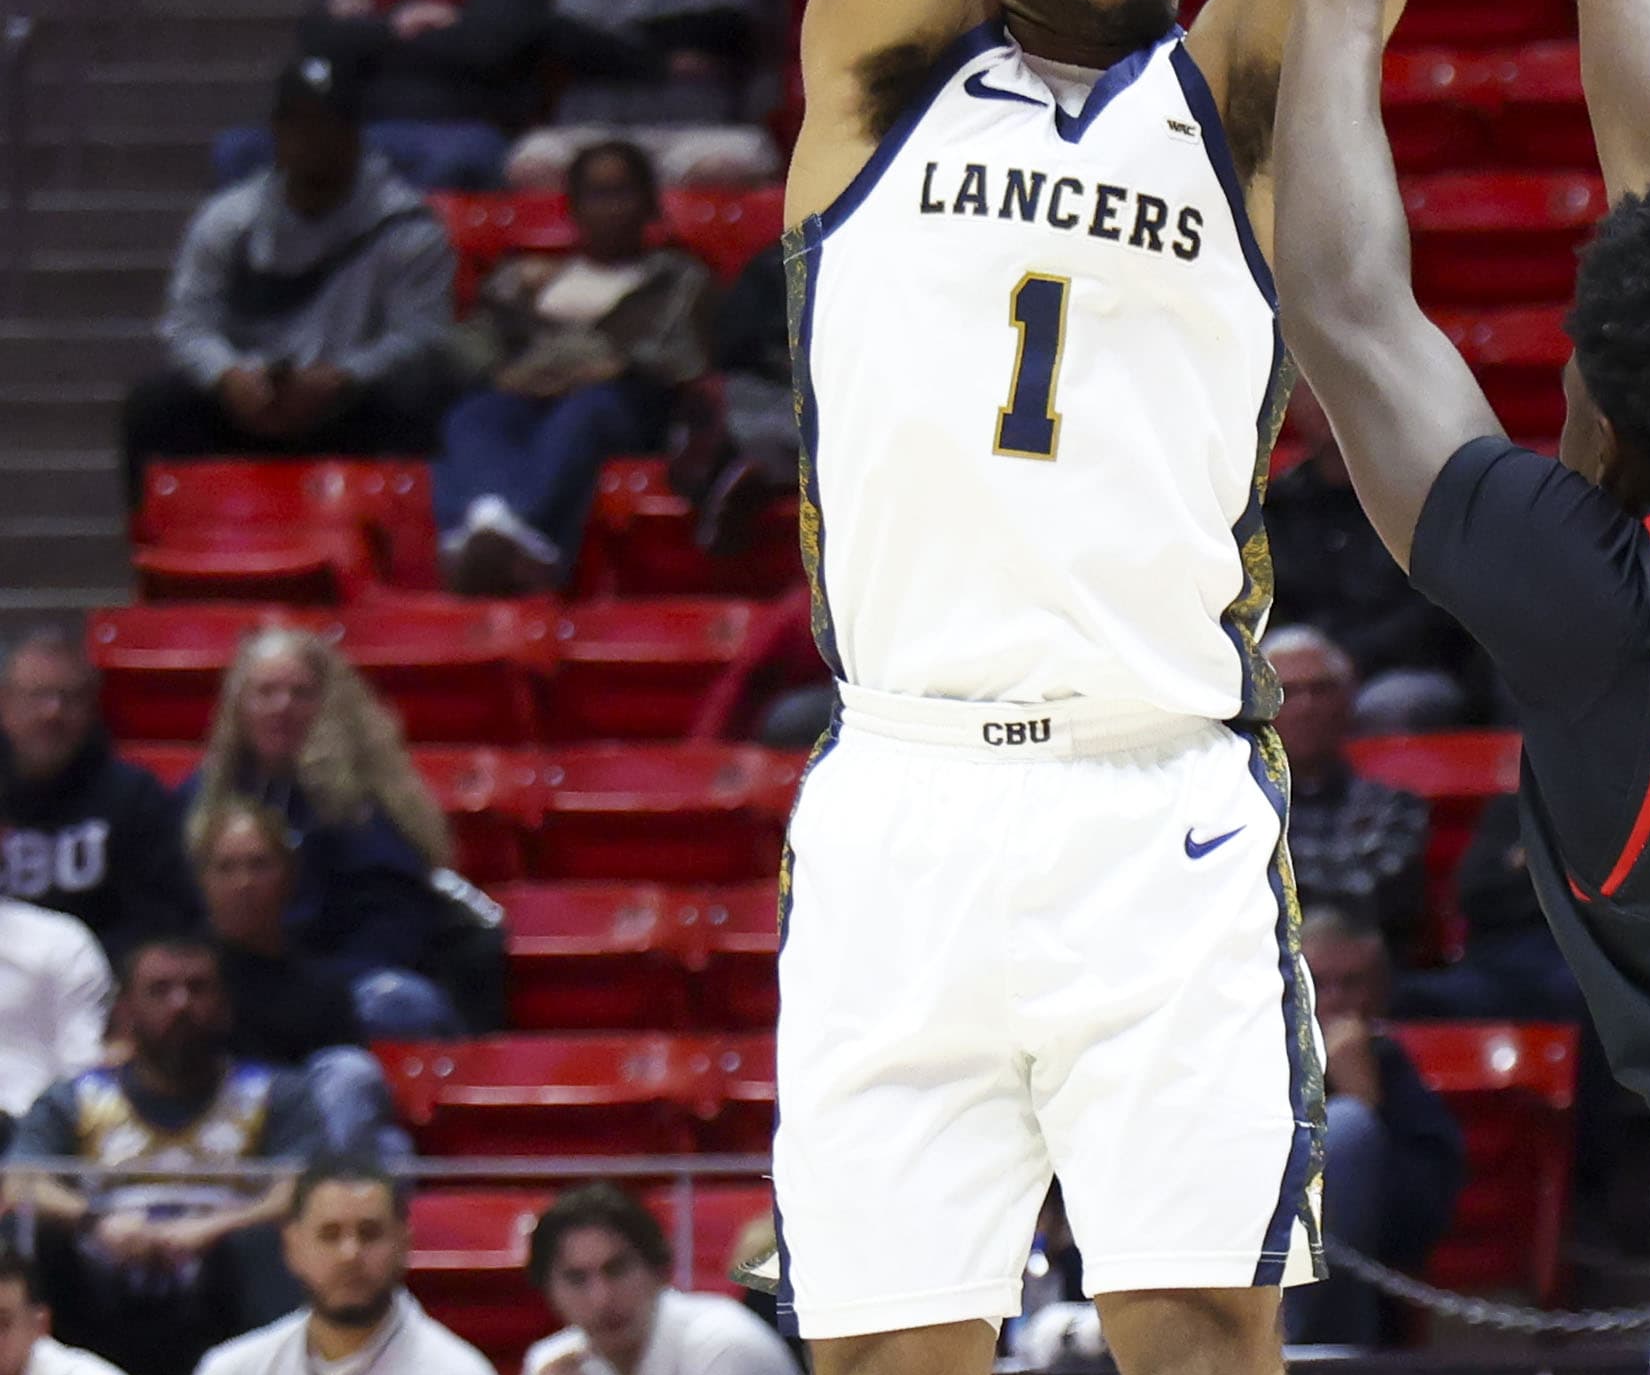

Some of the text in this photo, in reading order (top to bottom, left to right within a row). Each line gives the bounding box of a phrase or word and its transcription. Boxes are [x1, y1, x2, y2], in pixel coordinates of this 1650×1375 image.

[920, 161, 1205, 262] LANCERS
[992, 270, 1072, 462] 1
[982, 717, 1052, 746] CBU
